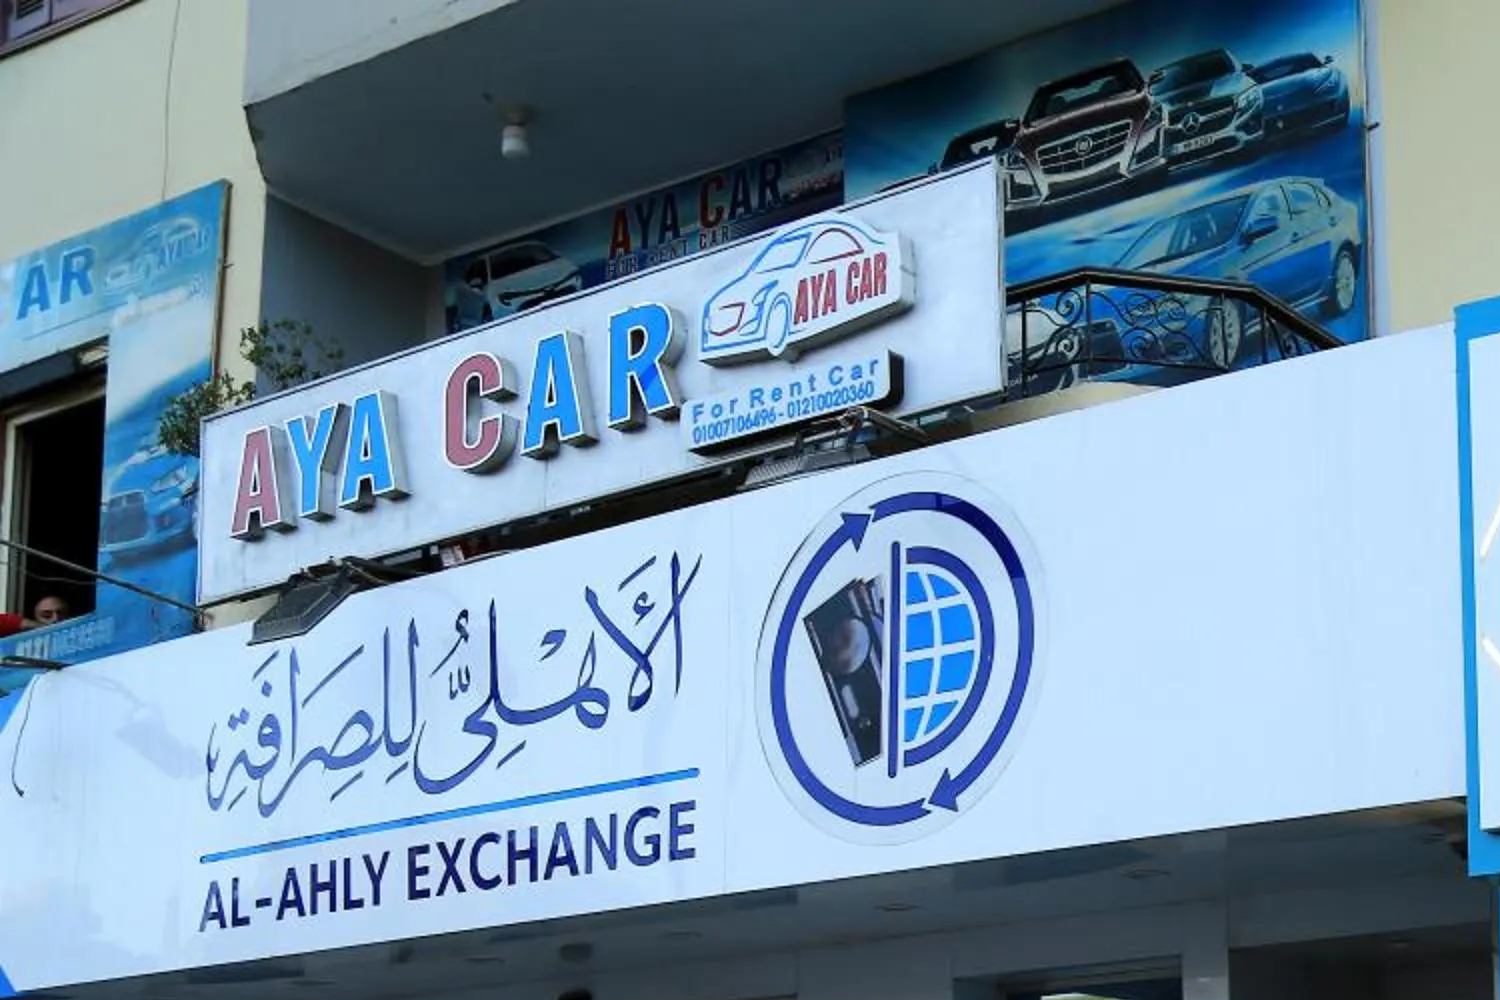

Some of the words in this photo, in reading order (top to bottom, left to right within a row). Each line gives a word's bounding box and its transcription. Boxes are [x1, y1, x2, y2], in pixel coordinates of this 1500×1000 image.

[608, 192, 682, 260] AYA
[700, 158, 784, 228] CAR
[699, 226, 729, 249] CAR
[794, 268, 837, 325] AYA
[846, 252, 888, 305] CAR
[231, 389, 403, 540] AYA
[443, 302, 680, 472] CAR
[692, 398, 739, 424] For
[750, 373, 816, 409] Rent
[828, 359, 879, 386] Car
[200, 851, 391, 932] AL-AHLY
[407, 800, 697, 901] EXCHANGE
